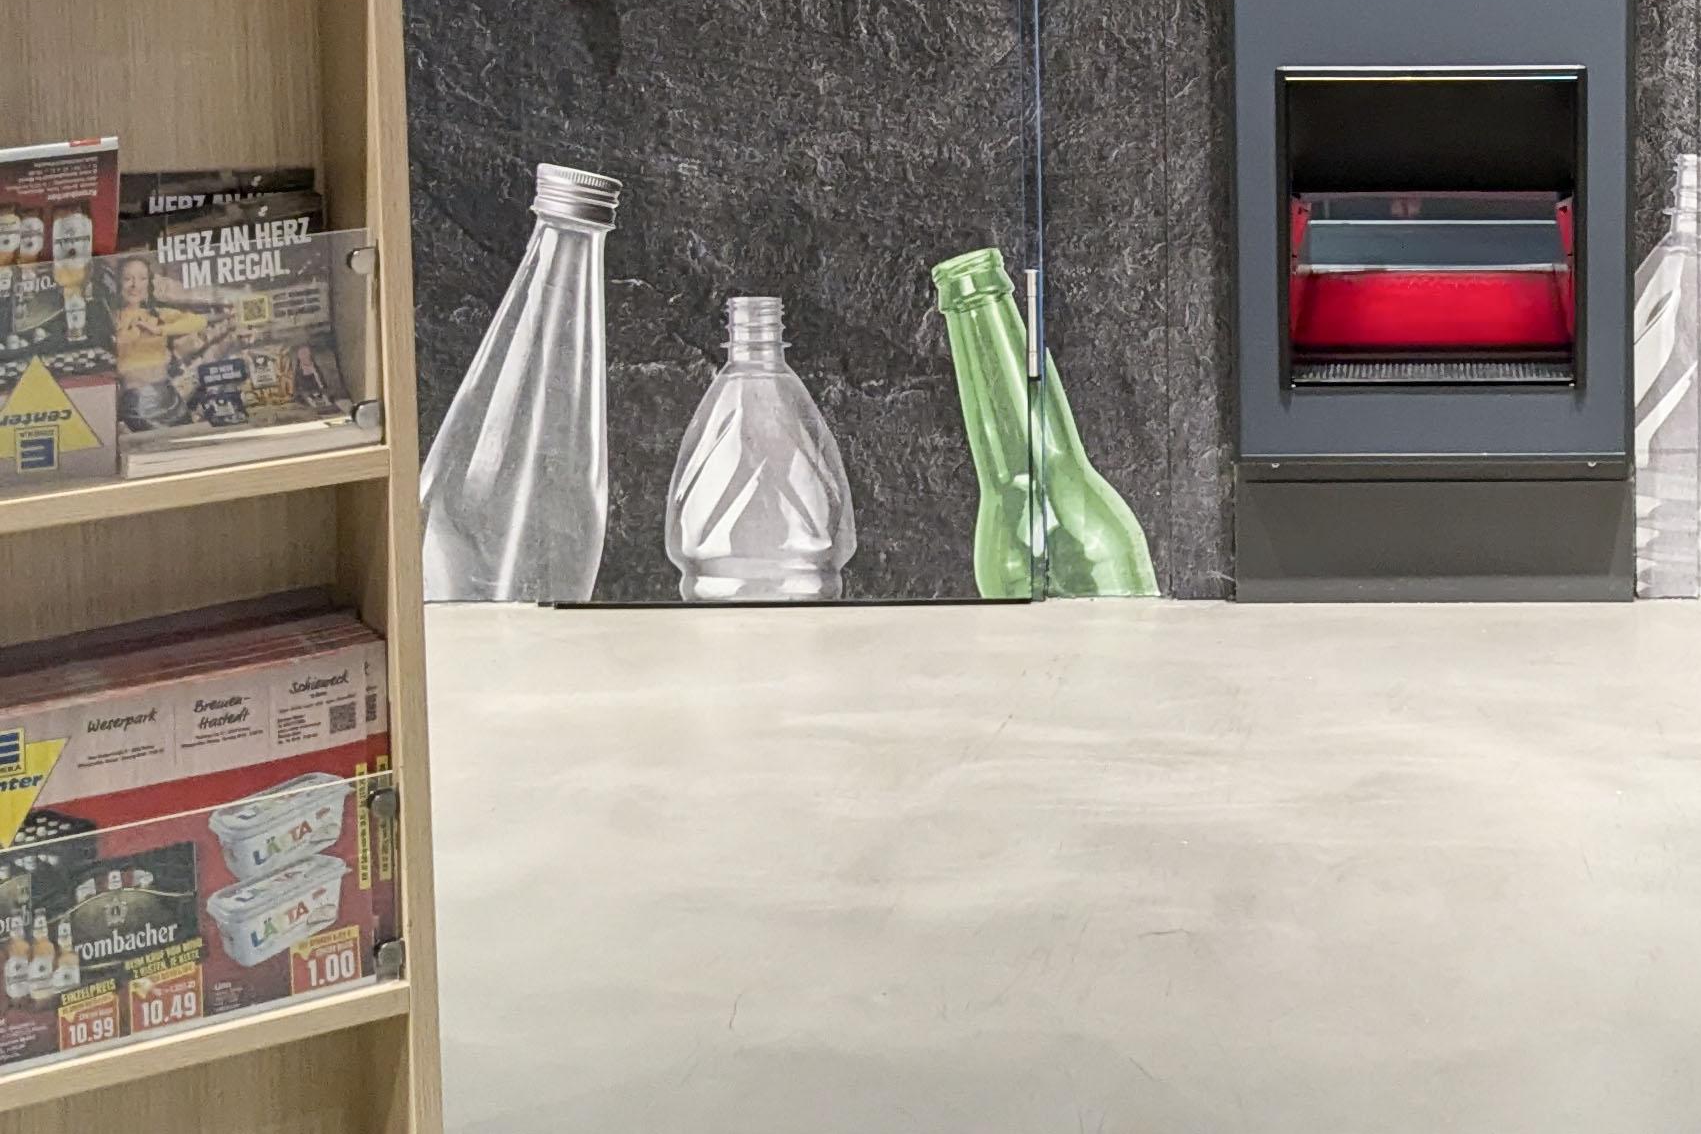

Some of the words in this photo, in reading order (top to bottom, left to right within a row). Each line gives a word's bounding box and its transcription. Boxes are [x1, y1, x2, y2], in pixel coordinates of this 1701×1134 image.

[157, 230, 216, 264] HERZ
[219, 224, 250, 255] AN
[255, 217, 312, 250] HERZ
[181, 259, 212, 290] IM
[217, 250, 291, 285] REGAL.
[87, 707, 159, 733] Weserpark
[252, 820, 313, 866] LÄTA
[74, 922, 178, 961] rombacher
[250, 900, 309, 948] LÄTA
[307, 950, 355, 987] 1.00
[142, 992, 197, 1027] 10.49
[69, 1016, 114, 1046] 10.99
